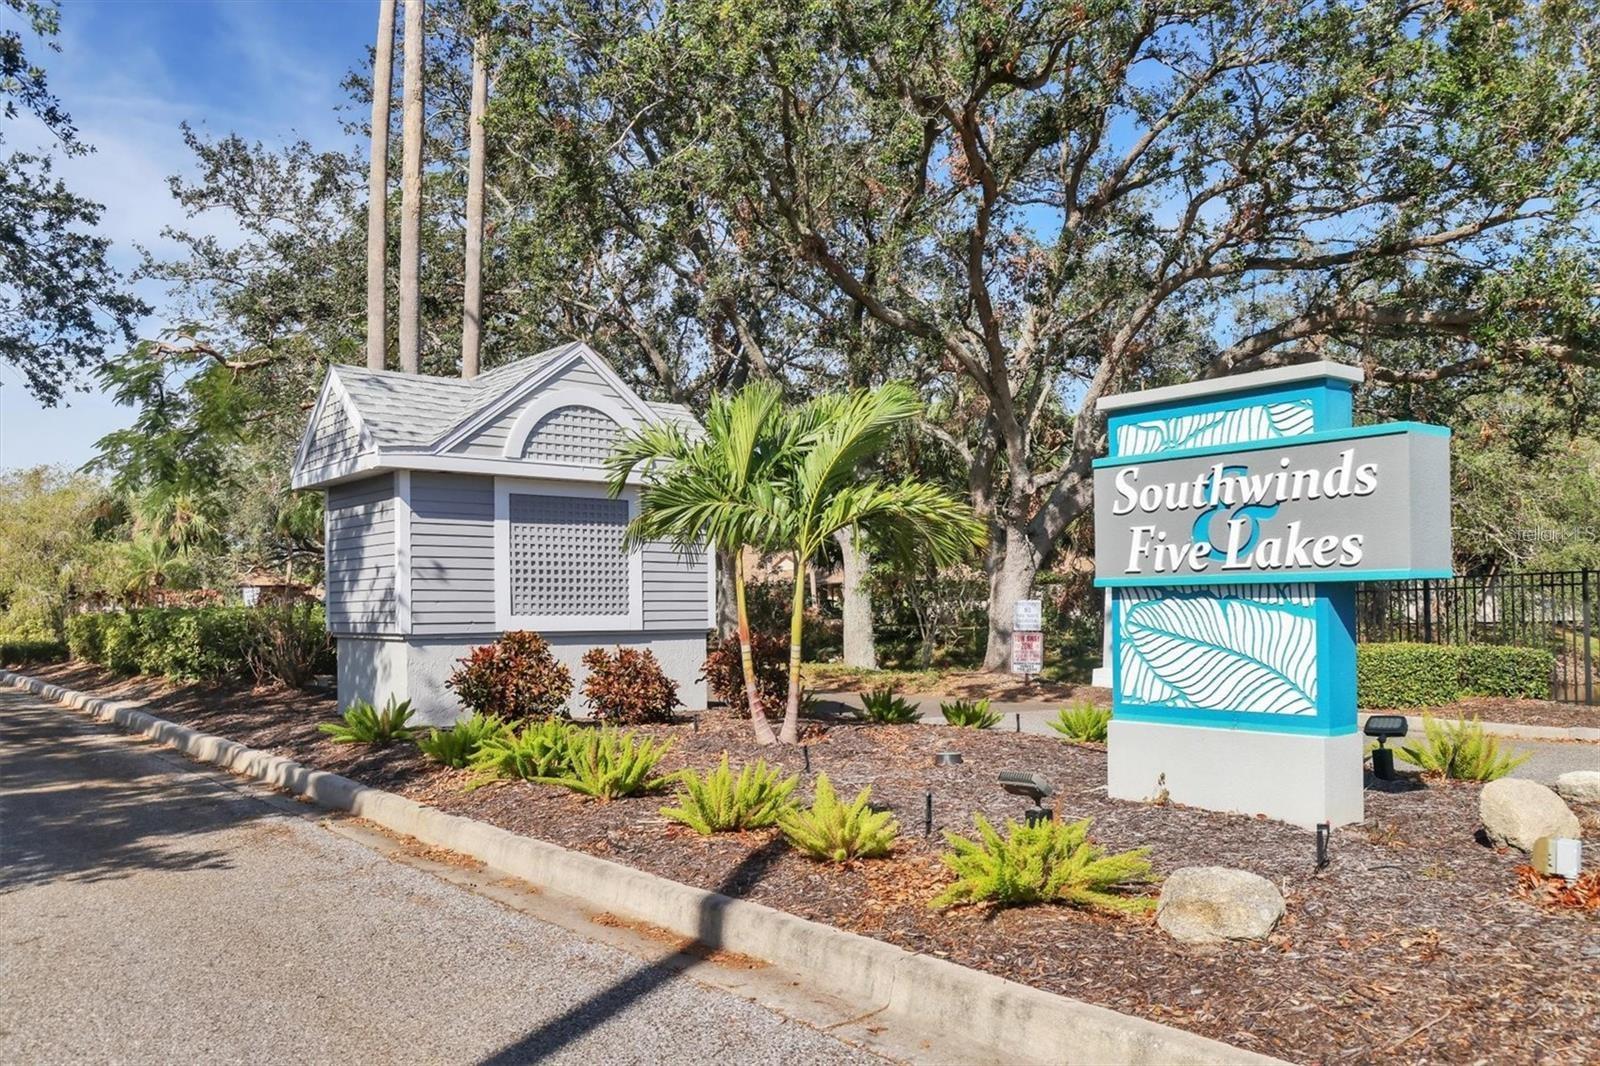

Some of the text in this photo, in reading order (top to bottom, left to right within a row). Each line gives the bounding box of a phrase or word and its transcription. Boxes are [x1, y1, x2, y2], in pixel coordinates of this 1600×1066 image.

[1112, 448, 1379, 516] Southwinds
[1192, 465, 1281, 561] &
[1124, 518, 1365, 574] Five Lakes
